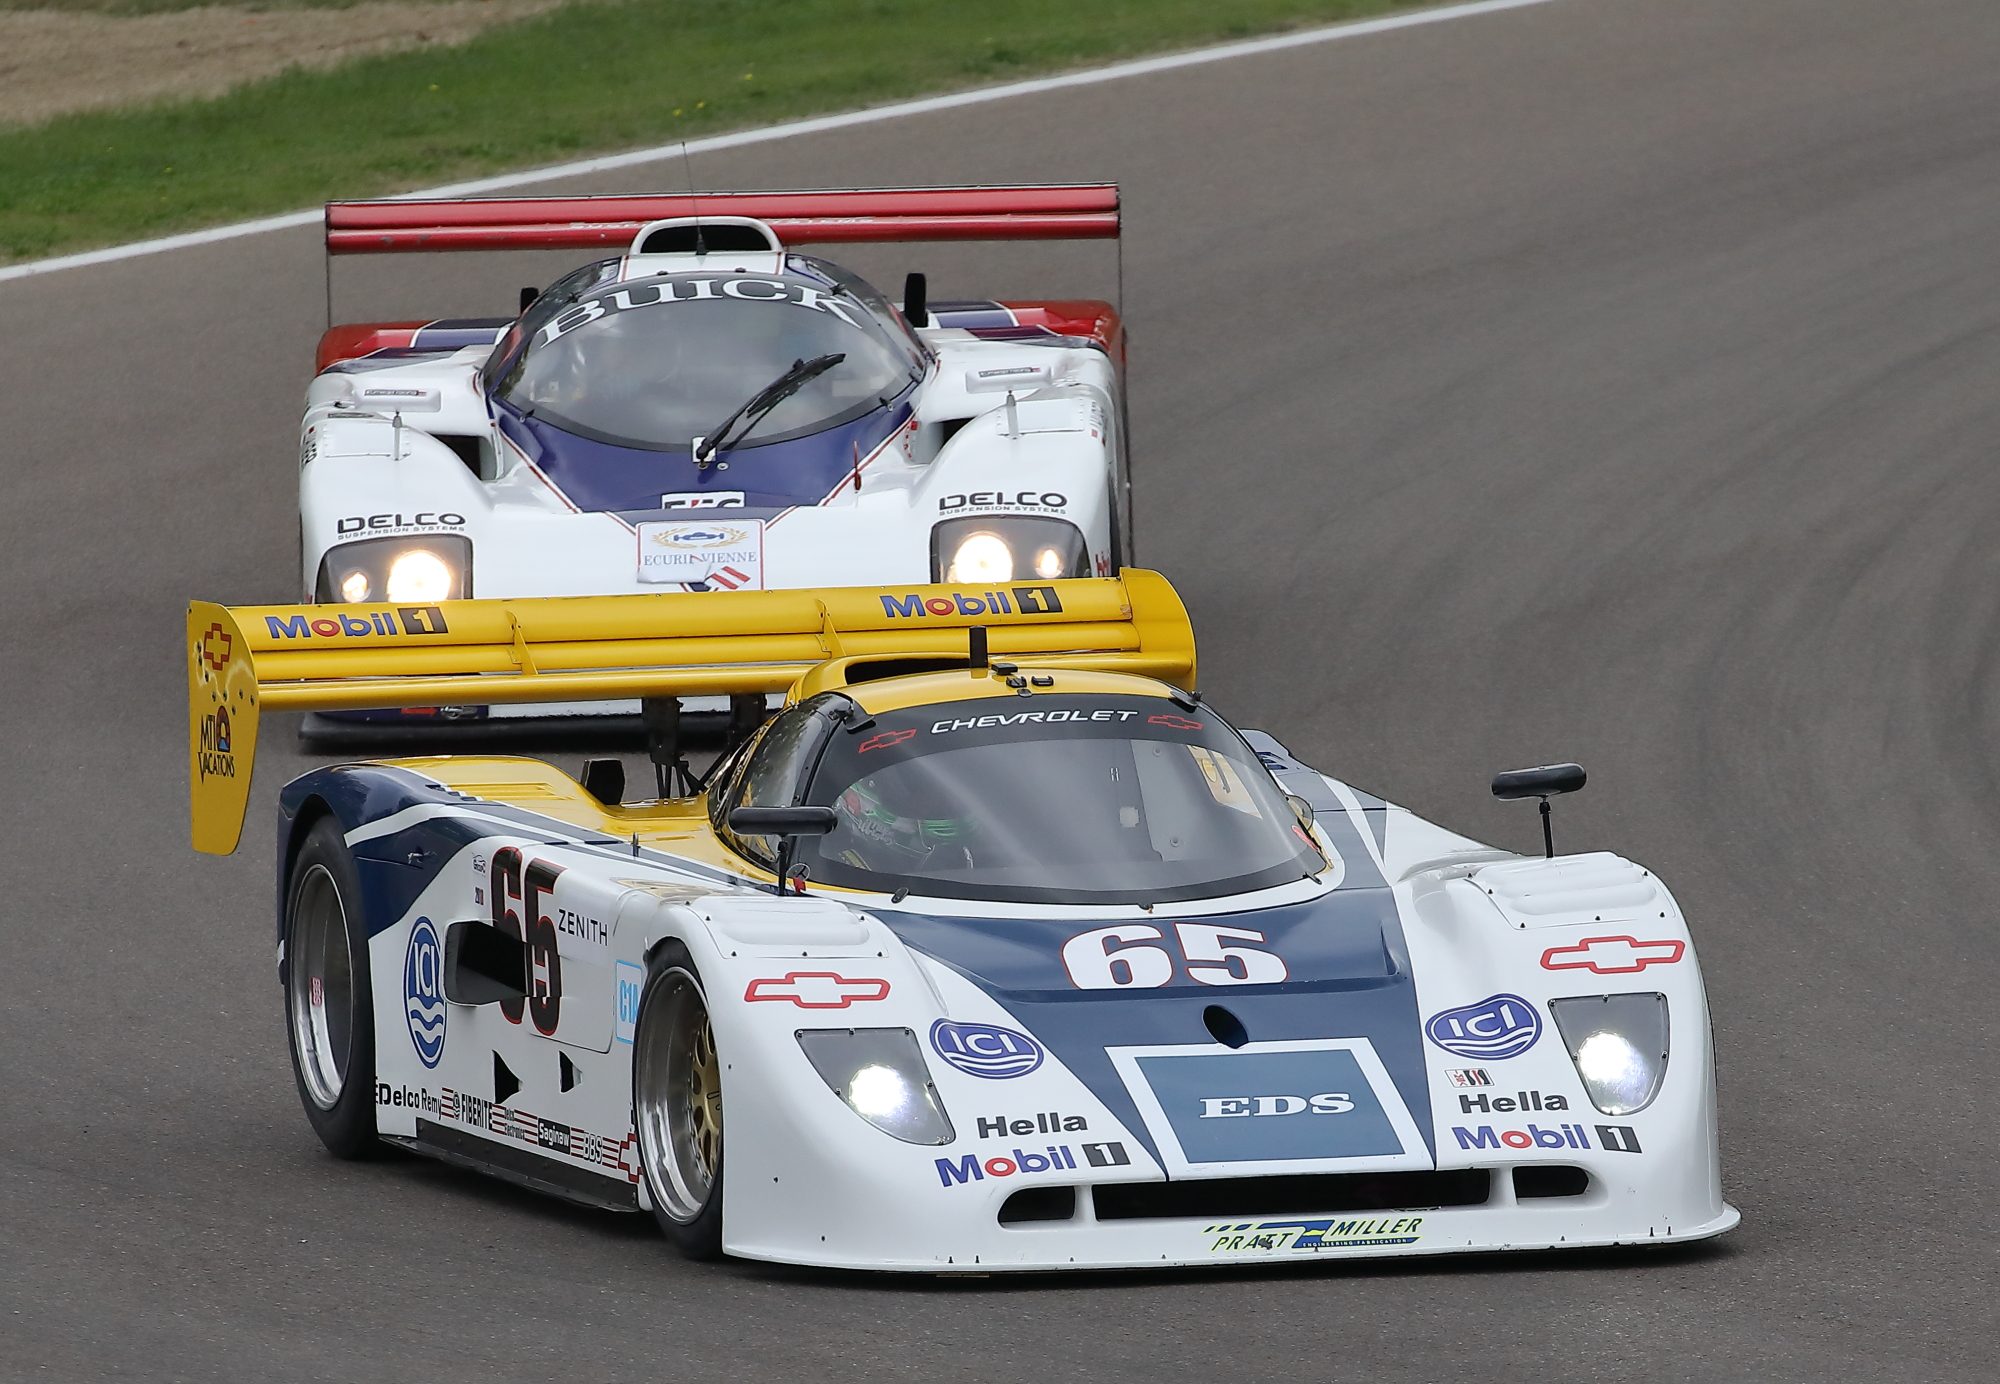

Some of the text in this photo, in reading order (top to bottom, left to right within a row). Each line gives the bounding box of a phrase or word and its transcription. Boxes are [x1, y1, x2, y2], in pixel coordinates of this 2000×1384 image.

[540, 278, 863, 349] BUICK
[938, 491, 1067, 510] DELCO
[939, 505, 1066, 516] SUSPENSION SYSTEMS
[337, 512, 466, 534] DELCO
[337, 527, 409, 540] SUSPENSION
[701, 551, 757, 564] VIENNE
[879, 588, 1054, 618] Mobil 1
[264, 608, 440, 639] Mobil 1
[930, 709, 1139, 735] CHEVROLET
[558, 908, 608, 947] ZENITH
[414, 941, 437, 998] ICI
[1061, 922, 1289, 990] 65
[1448, 1003, 1516, 1037] ICI
[949, 1029, 1018, 1055] ICI
[379, 1083, 420, 1109] Delco
[421, 1088, 441, 1121] Remy
[461, 1093, 493, 1131] FIBERITE
[1199, 1093, 1355, 1118] EDS
[1458, 1090, 1569, 1114] Hella
[539, 1122, 569, 1147] Saginaw
[976, 1112, 1088, 1140] Hella
[1451, 1124, 1636, 1152] Mobil 1
[583, 1132, 603, 1164] BBS
[934, 1143, 1123, 1188] Mobil 1
[1330, 1218, 1423, 1237] MILLER
